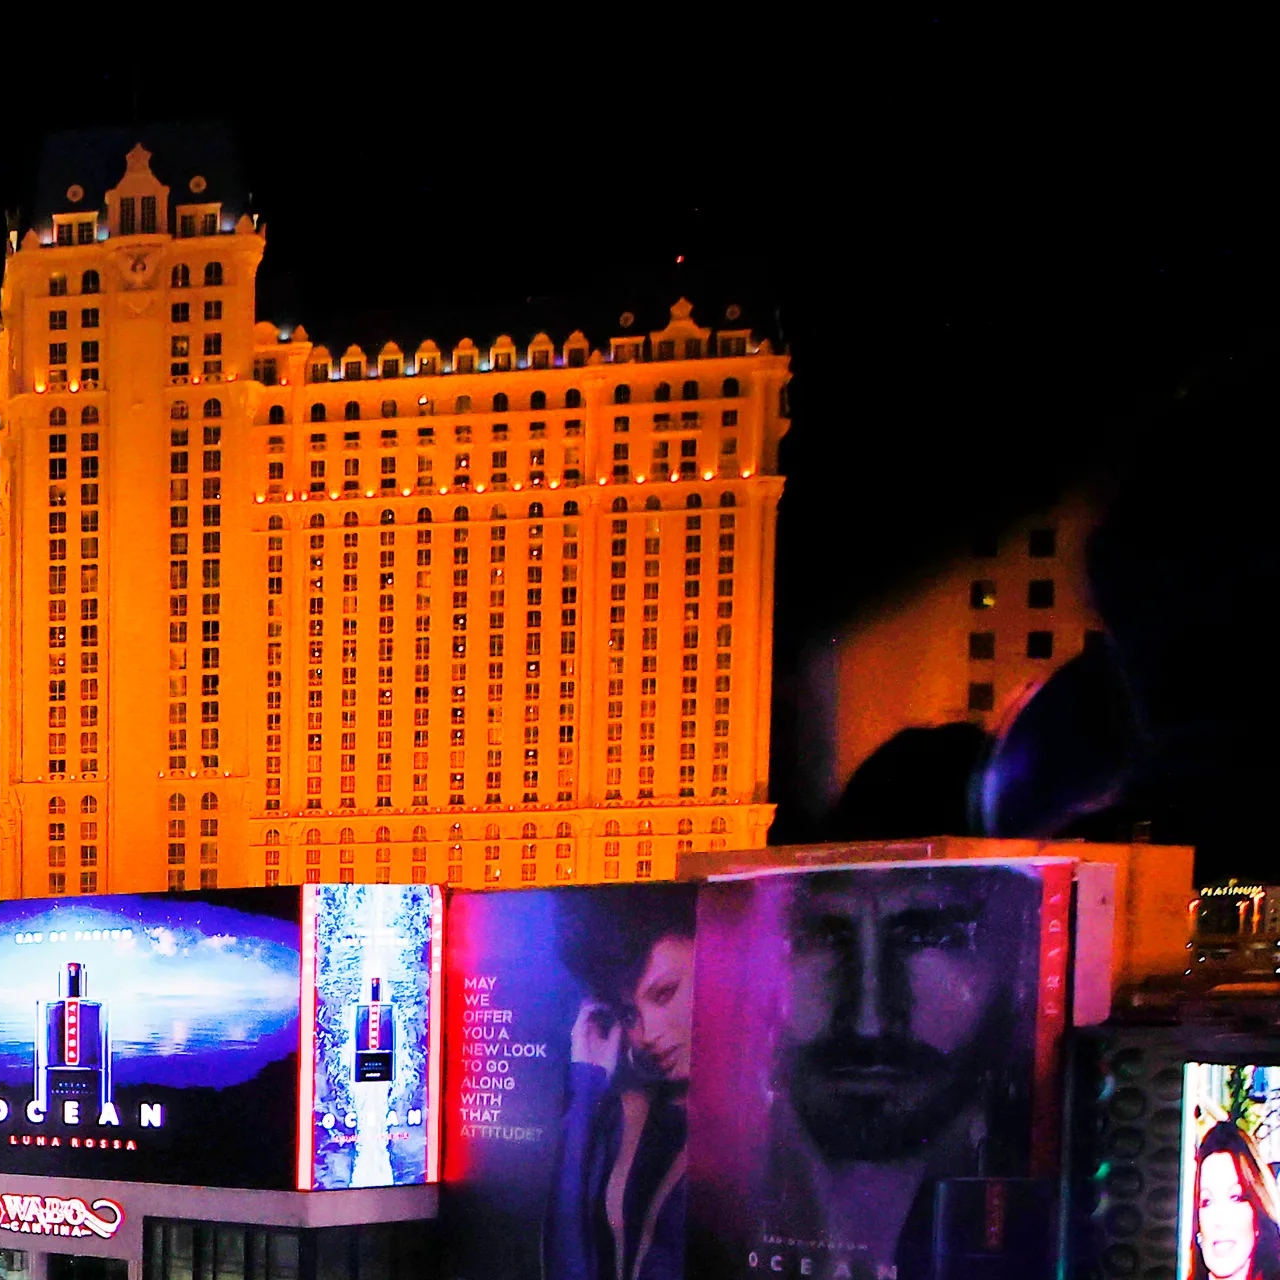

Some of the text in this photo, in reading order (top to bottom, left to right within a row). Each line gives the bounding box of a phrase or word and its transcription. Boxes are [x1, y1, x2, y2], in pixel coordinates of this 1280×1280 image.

[1200, 885, 1264, 897] PLATINUM
[15, 929, 134, 944] EAU DE PARFUM
[464, 976, 497, 990] MAY
[464, 993, 490, 1006] WE
[463, 1010, 513, 1024] OFFER
[462, 1026, 510, 1040] YOU A
[462, 1043, 547, 1058] NEW LOOK
[461, 1059, 509, 1073] TO GO
[461, 1076, 516, 1090] ALONG
[460, 1092, 502, 1107] WITH
[460, 1108, 501, 1122] THAT
[460, 1124, 544, 1142] ATTITUDE?
[8, 1134, 138, 1151] LUNA ROSSA
[2, 1194, 105, 1232] WABO
[9, 1222, 82, 1238] CANTINA
[748, 1251, 899, 1280] OCEAN
